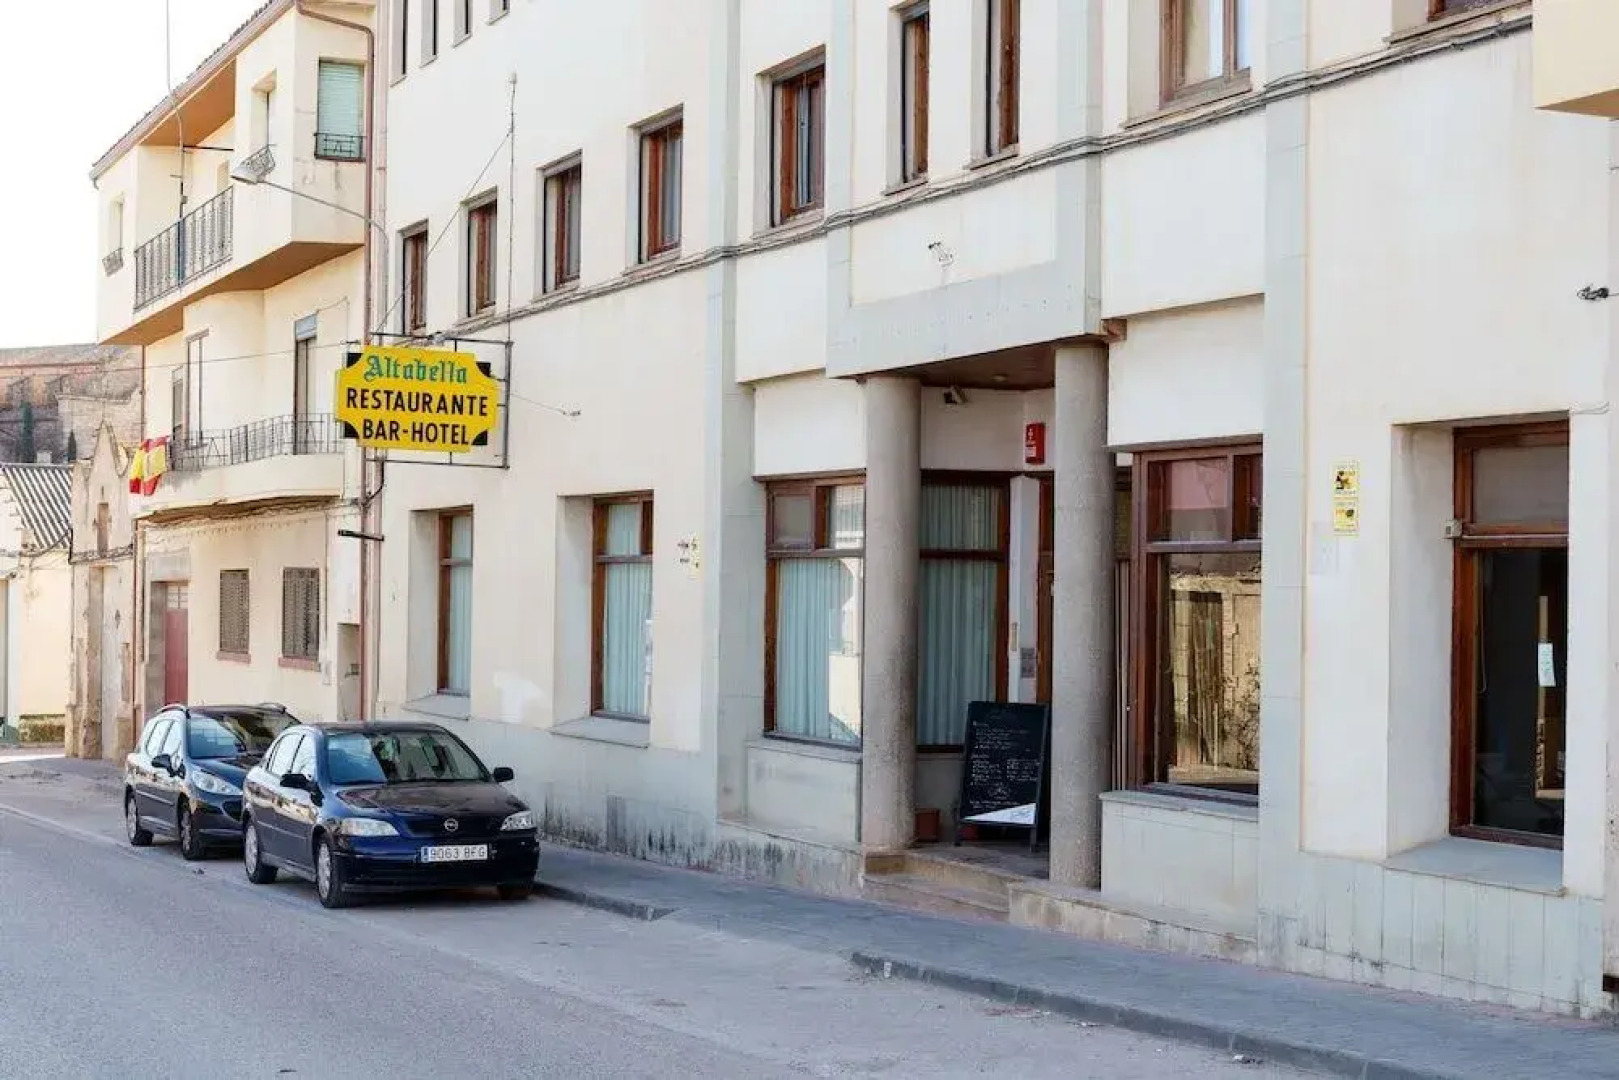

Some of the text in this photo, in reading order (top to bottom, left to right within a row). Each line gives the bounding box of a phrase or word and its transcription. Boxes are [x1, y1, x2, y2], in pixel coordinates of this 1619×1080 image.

[364, 355, 467, 384] Altabella
[346, 387, 488, 417] RESTAURANTE
[430, 848, 459, 860] 9063
